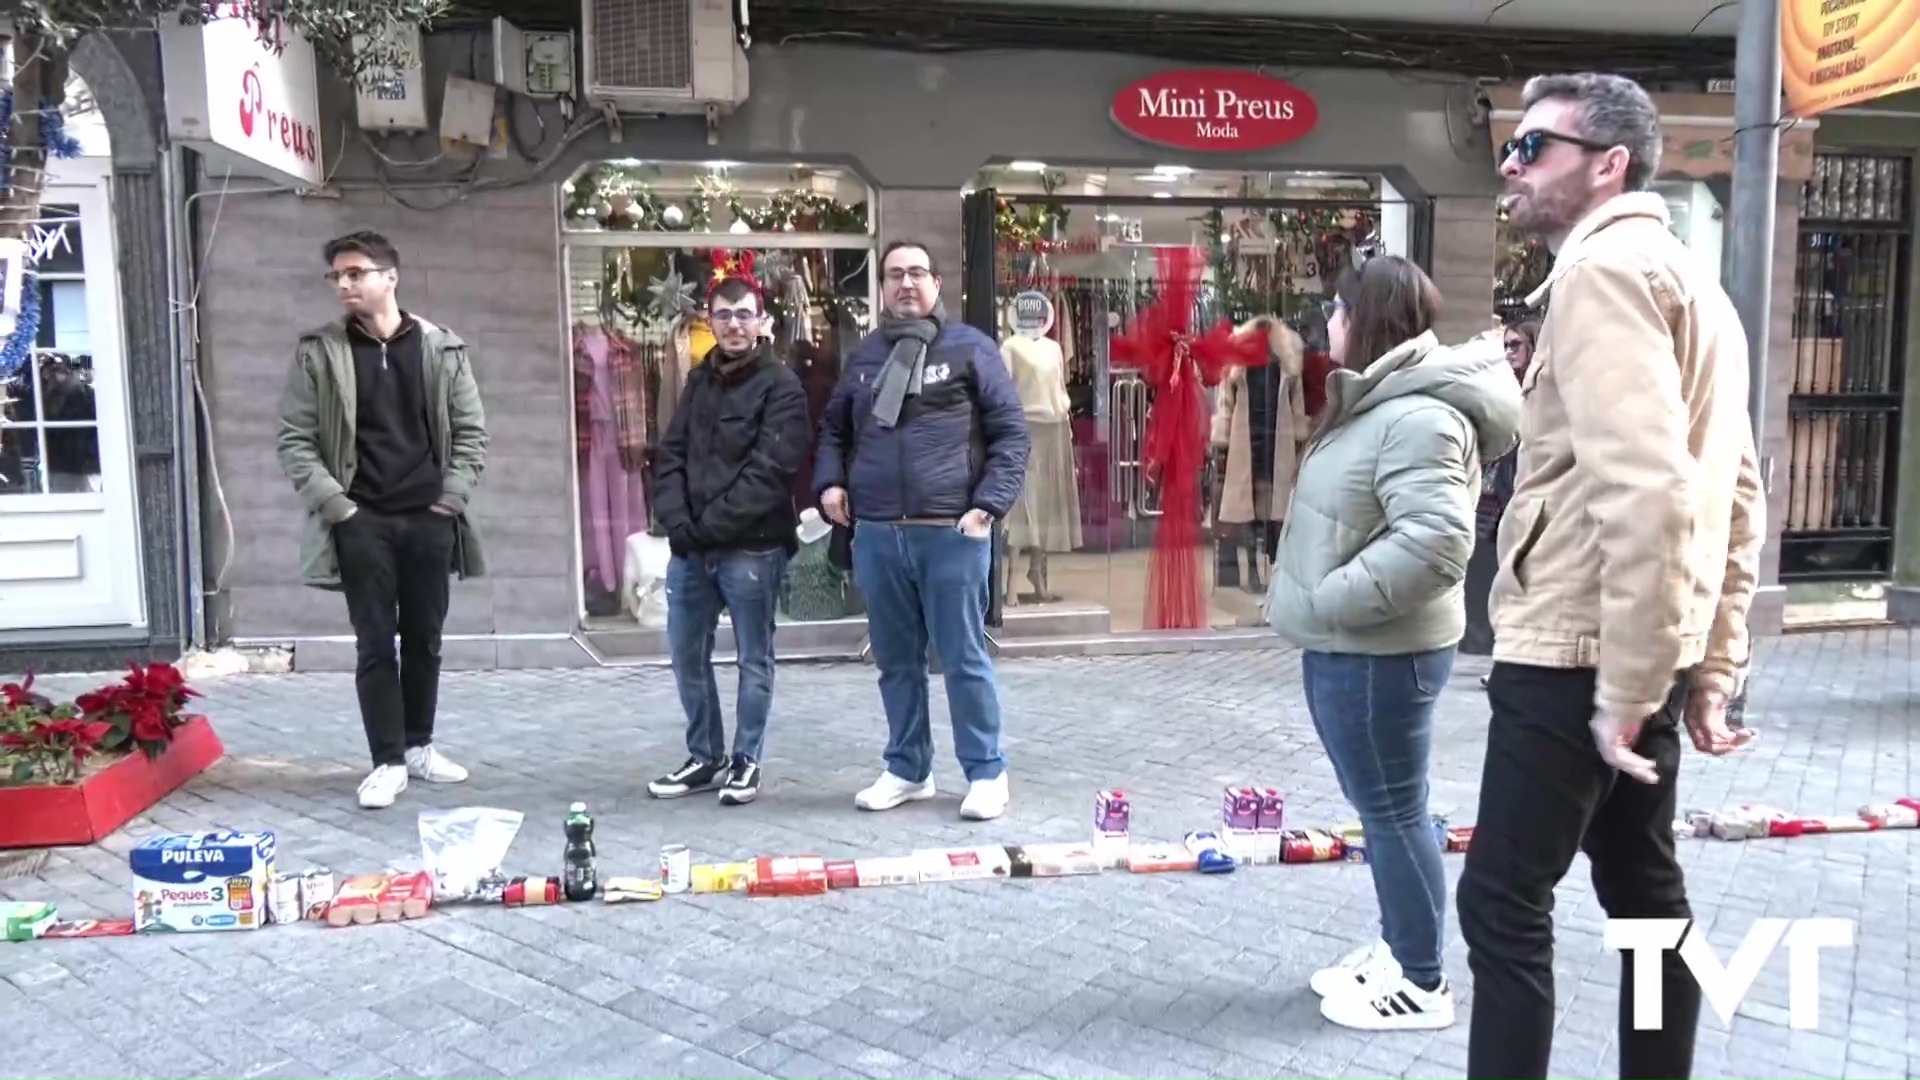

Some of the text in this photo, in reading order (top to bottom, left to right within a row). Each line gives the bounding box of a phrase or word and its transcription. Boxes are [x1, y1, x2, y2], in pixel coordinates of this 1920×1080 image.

[1835, 12, 1860, 34] STORY
[1138, 88, 1294, 120] Mini Preus
[239, 62, 315, 163] Preus
[1196, 122, 1239, 138] Moda
[1017, 299, 1042, 312] BONO
[161, 849, 225, 864] PULEVA
[161, 887, 225, 901] Peques 3
